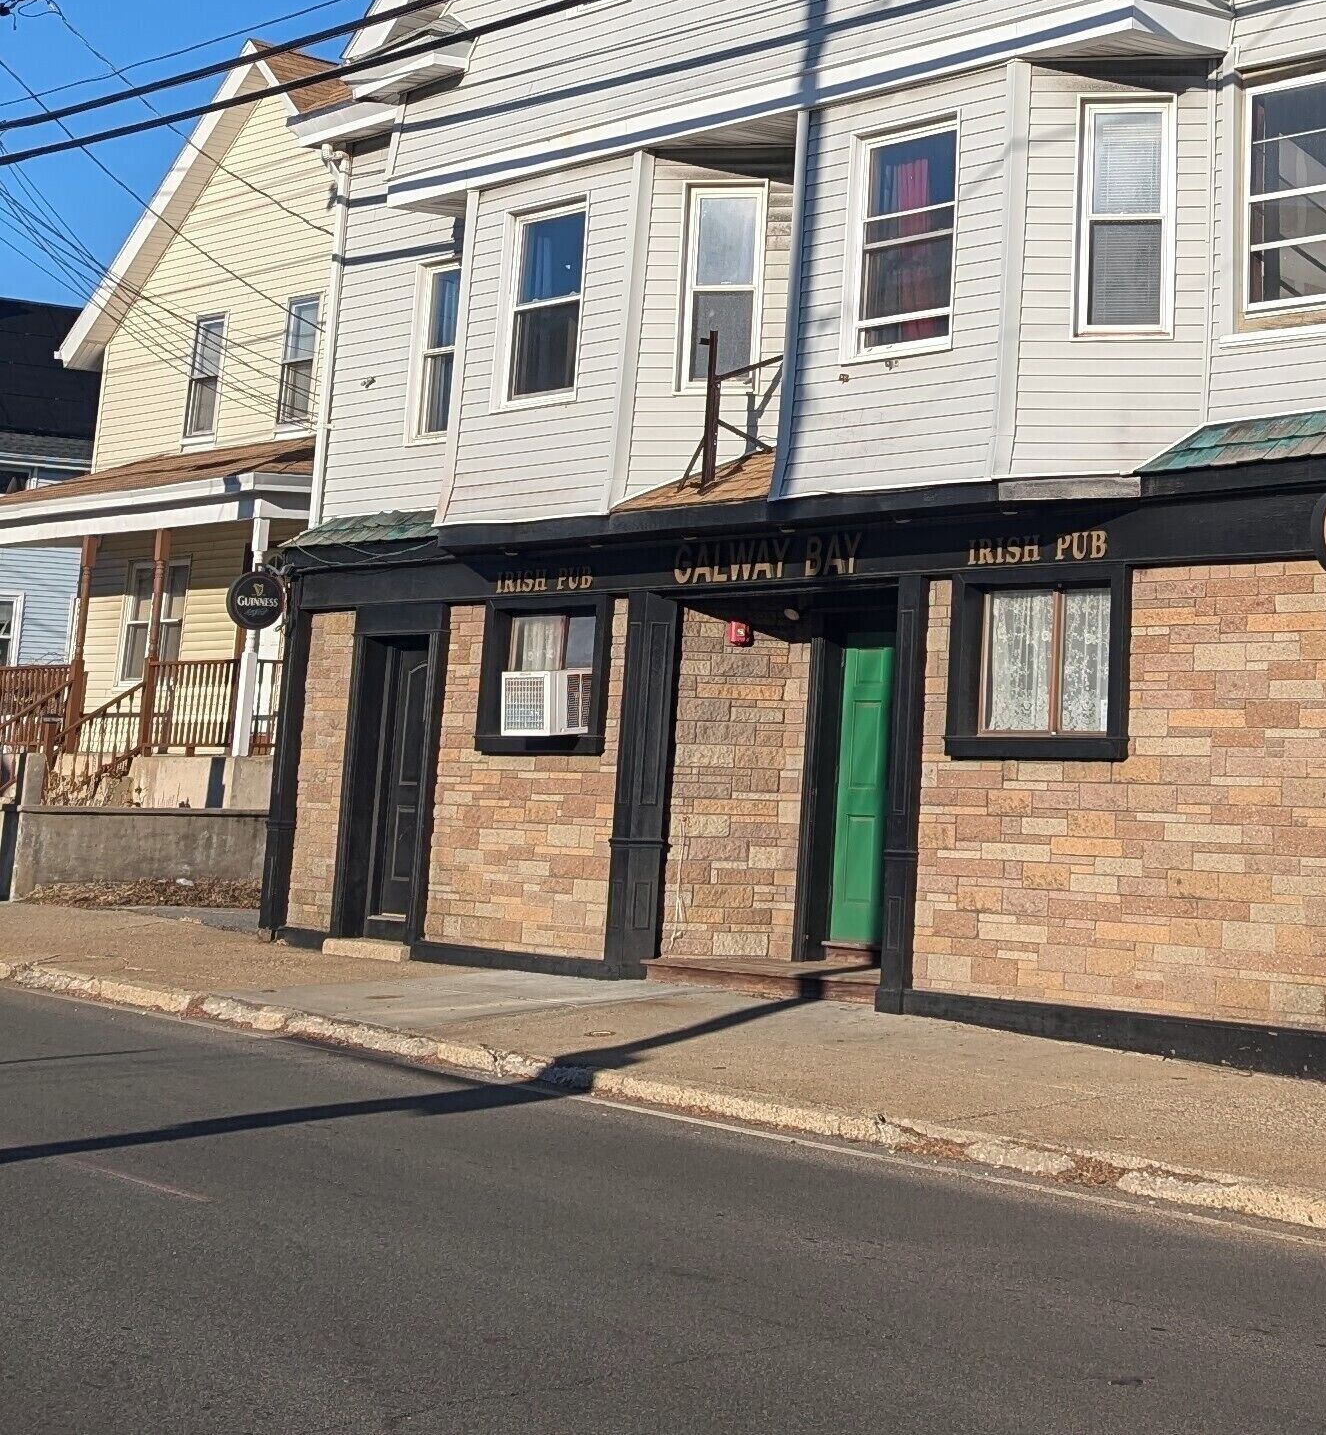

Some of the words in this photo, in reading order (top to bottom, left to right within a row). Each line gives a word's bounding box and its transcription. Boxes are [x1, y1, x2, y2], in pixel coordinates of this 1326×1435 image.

[673, 539, 790, 584] GALWAY
[804, 532, 862, 577] BAY
[968, 534, 1041, 565] IRISH
[1055, 530, 1107, 560] PUB
[496, 568, 547, 593] IRISH
[557, 565, 593, 590] PUB
[237, 595, 278, 607] GUINNESS
